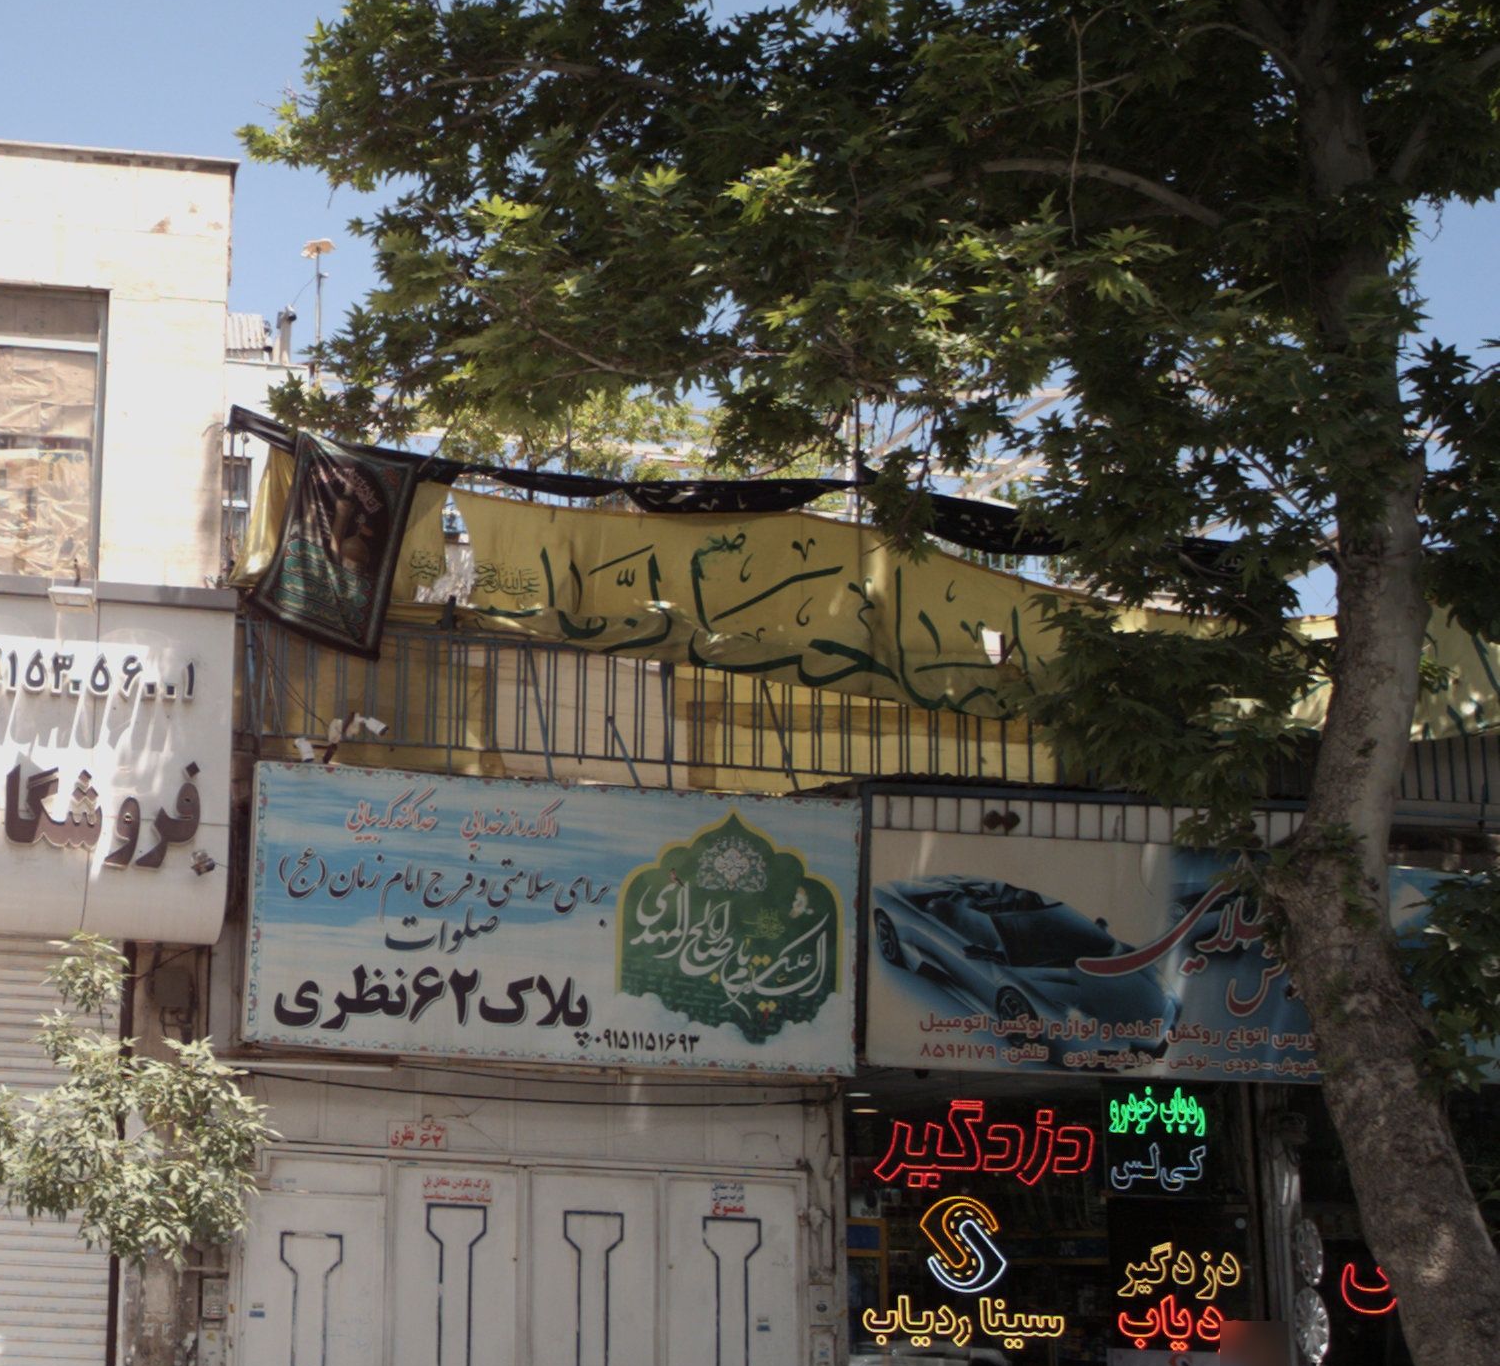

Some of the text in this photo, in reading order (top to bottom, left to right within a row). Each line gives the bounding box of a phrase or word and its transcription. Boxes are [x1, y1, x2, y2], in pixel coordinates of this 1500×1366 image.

[328, 854, 385, 899] زمان
[377, 861, 423, 924] امام
[422, 853, 476, 910] فرج
[487, 857, 555, 909] سلامتی
[554, 874, 611, 928] برای
[385, 906, 500, 954] صلوات
[273, 963, 409, 1032] نظری
[478, 972, 592, 1048] پلاک
[919, 1012, 989, 1035] اتومبیل
[992, 1013, 1045, 1036] لوکس
[1049, 1017, 1098, 1041] لوازم
[1115, 1017, 1163, 1039] آماده
[1166, 1023, 1221, 1046] روکش
[1224, 1027, 1268, 1051] انواع
[873, 1099, 1095, 1188] دزدگیر
[862, 1294, 1065, 1349] سینا ردیاب
